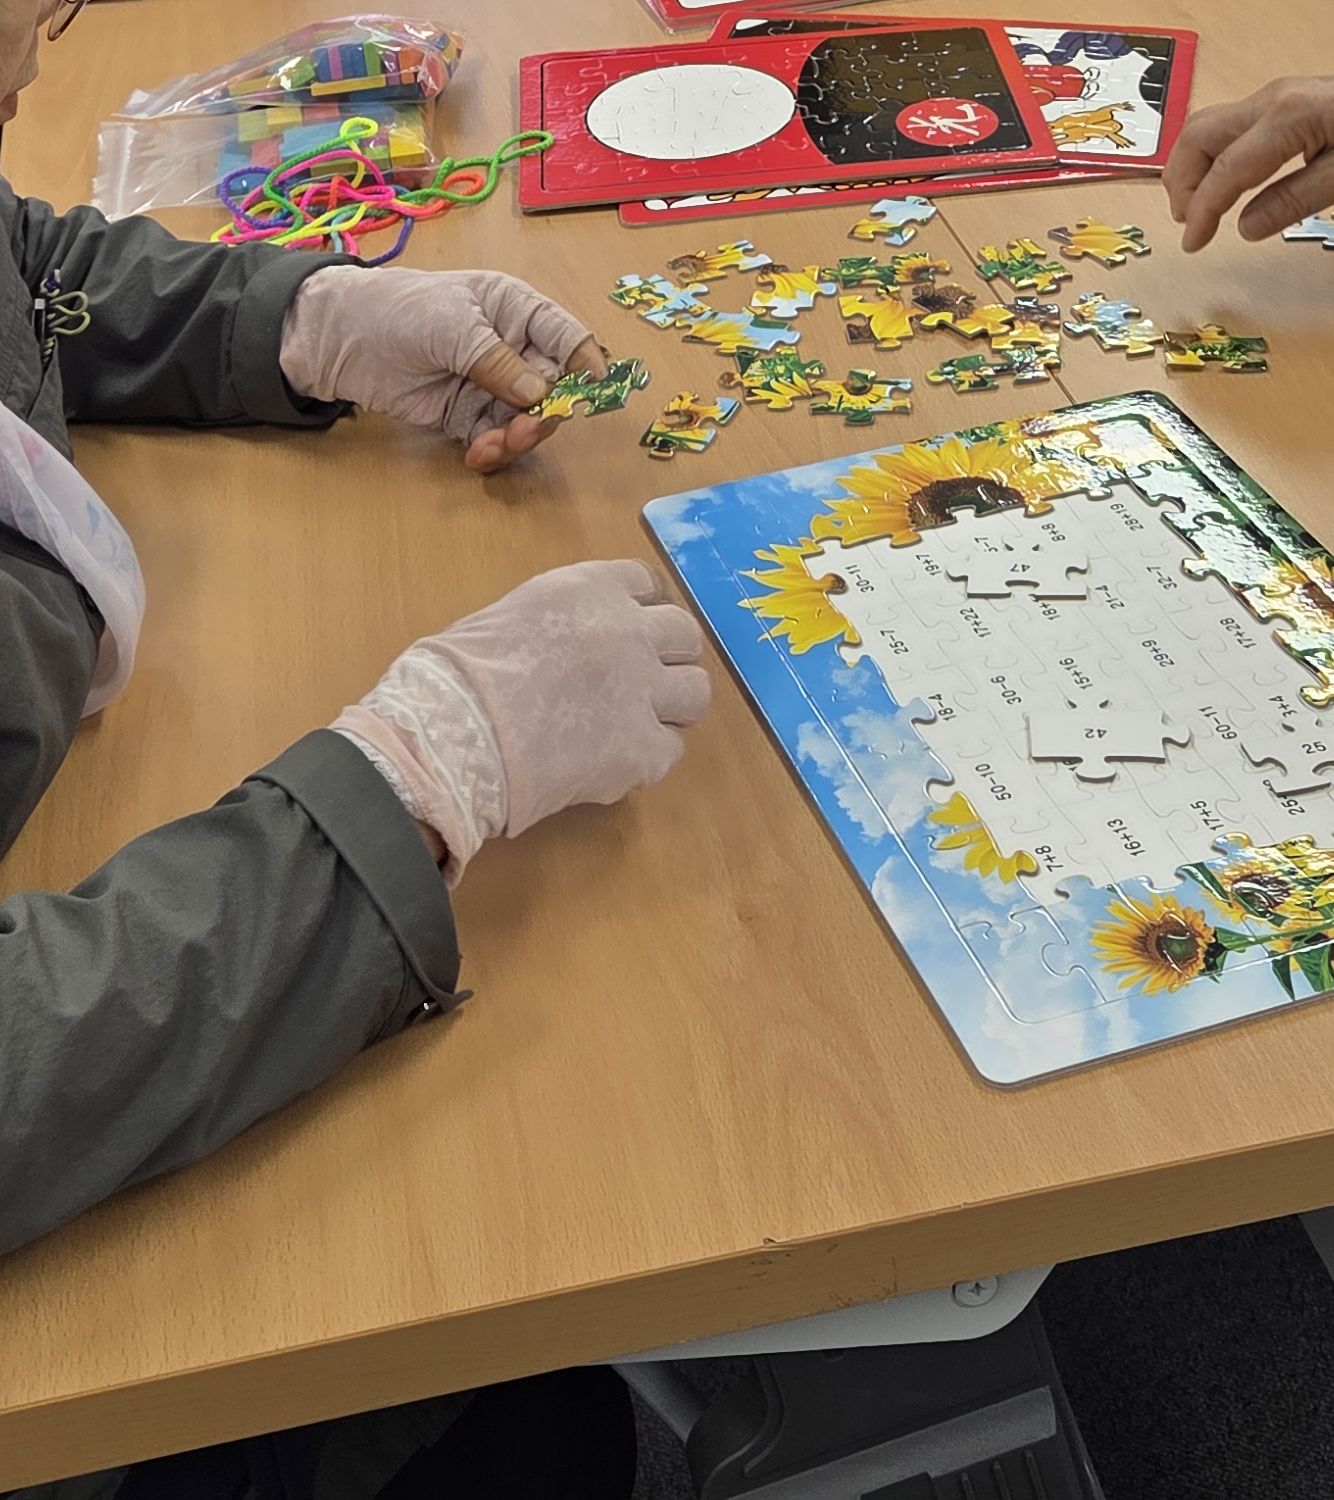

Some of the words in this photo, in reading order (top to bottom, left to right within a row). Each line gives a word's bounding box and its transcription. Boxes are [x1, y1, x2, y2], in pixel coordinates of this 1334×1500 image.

[1110, 502, 1145, 531] 28+19
[1041, 523, 1066, 542] 8+8
[845, 563, 875, 594] 30-11
[915, 554, 942, 576] 19+7
[1145, 564, 1179, 590] 32-7
[1094, 584, 1125, 610] 21-4
[959, 607, 991, 638] 17+22
[1218, 617, 1258, 649] 17+28
[879, 630, 909, 655] 25-7
[1141, 639, 1175, 668] 29+9
[1058, 657, 1093, 690] 15+16
[990, 675, 1022, 705] 30-6
[927, 693, 957, 722] 18-4
[1198, 705, 1238, 740] 60-11
[974, 763, 1012, 801] 50-10
[1189, 800, 1225, 831] 17+5
[1105, 818, 1146, 858] 16+13
[1034, 844, 1064, 873] 7+8
